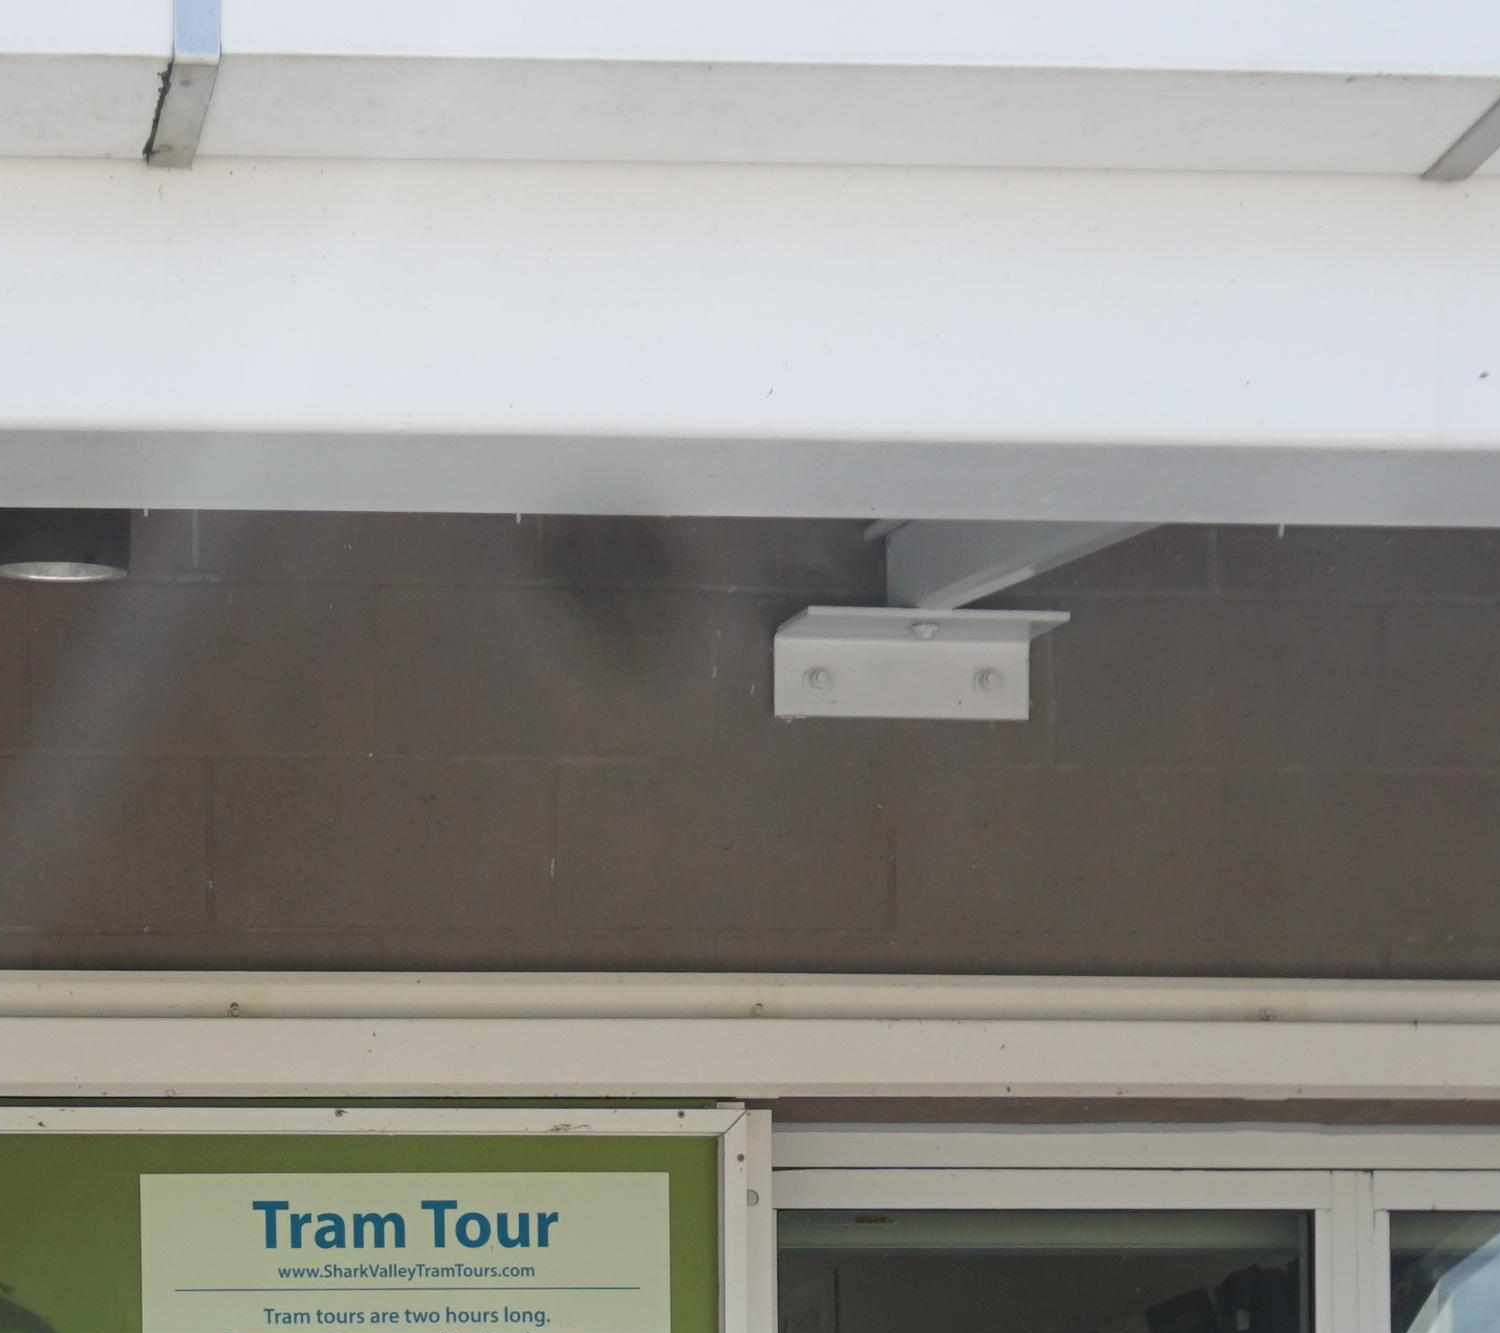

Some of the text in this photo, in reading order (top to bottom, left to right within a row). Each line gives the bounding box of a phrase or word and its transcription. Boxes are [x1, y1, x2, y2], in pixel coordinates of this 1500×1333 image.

[252, 1200, 558, 1249] Tram Tour
[278, 1264, 534, 1281] www.SharkValleyTramTours.com
[263, 1306, 550, 1327] Tram tours are two hours long.
